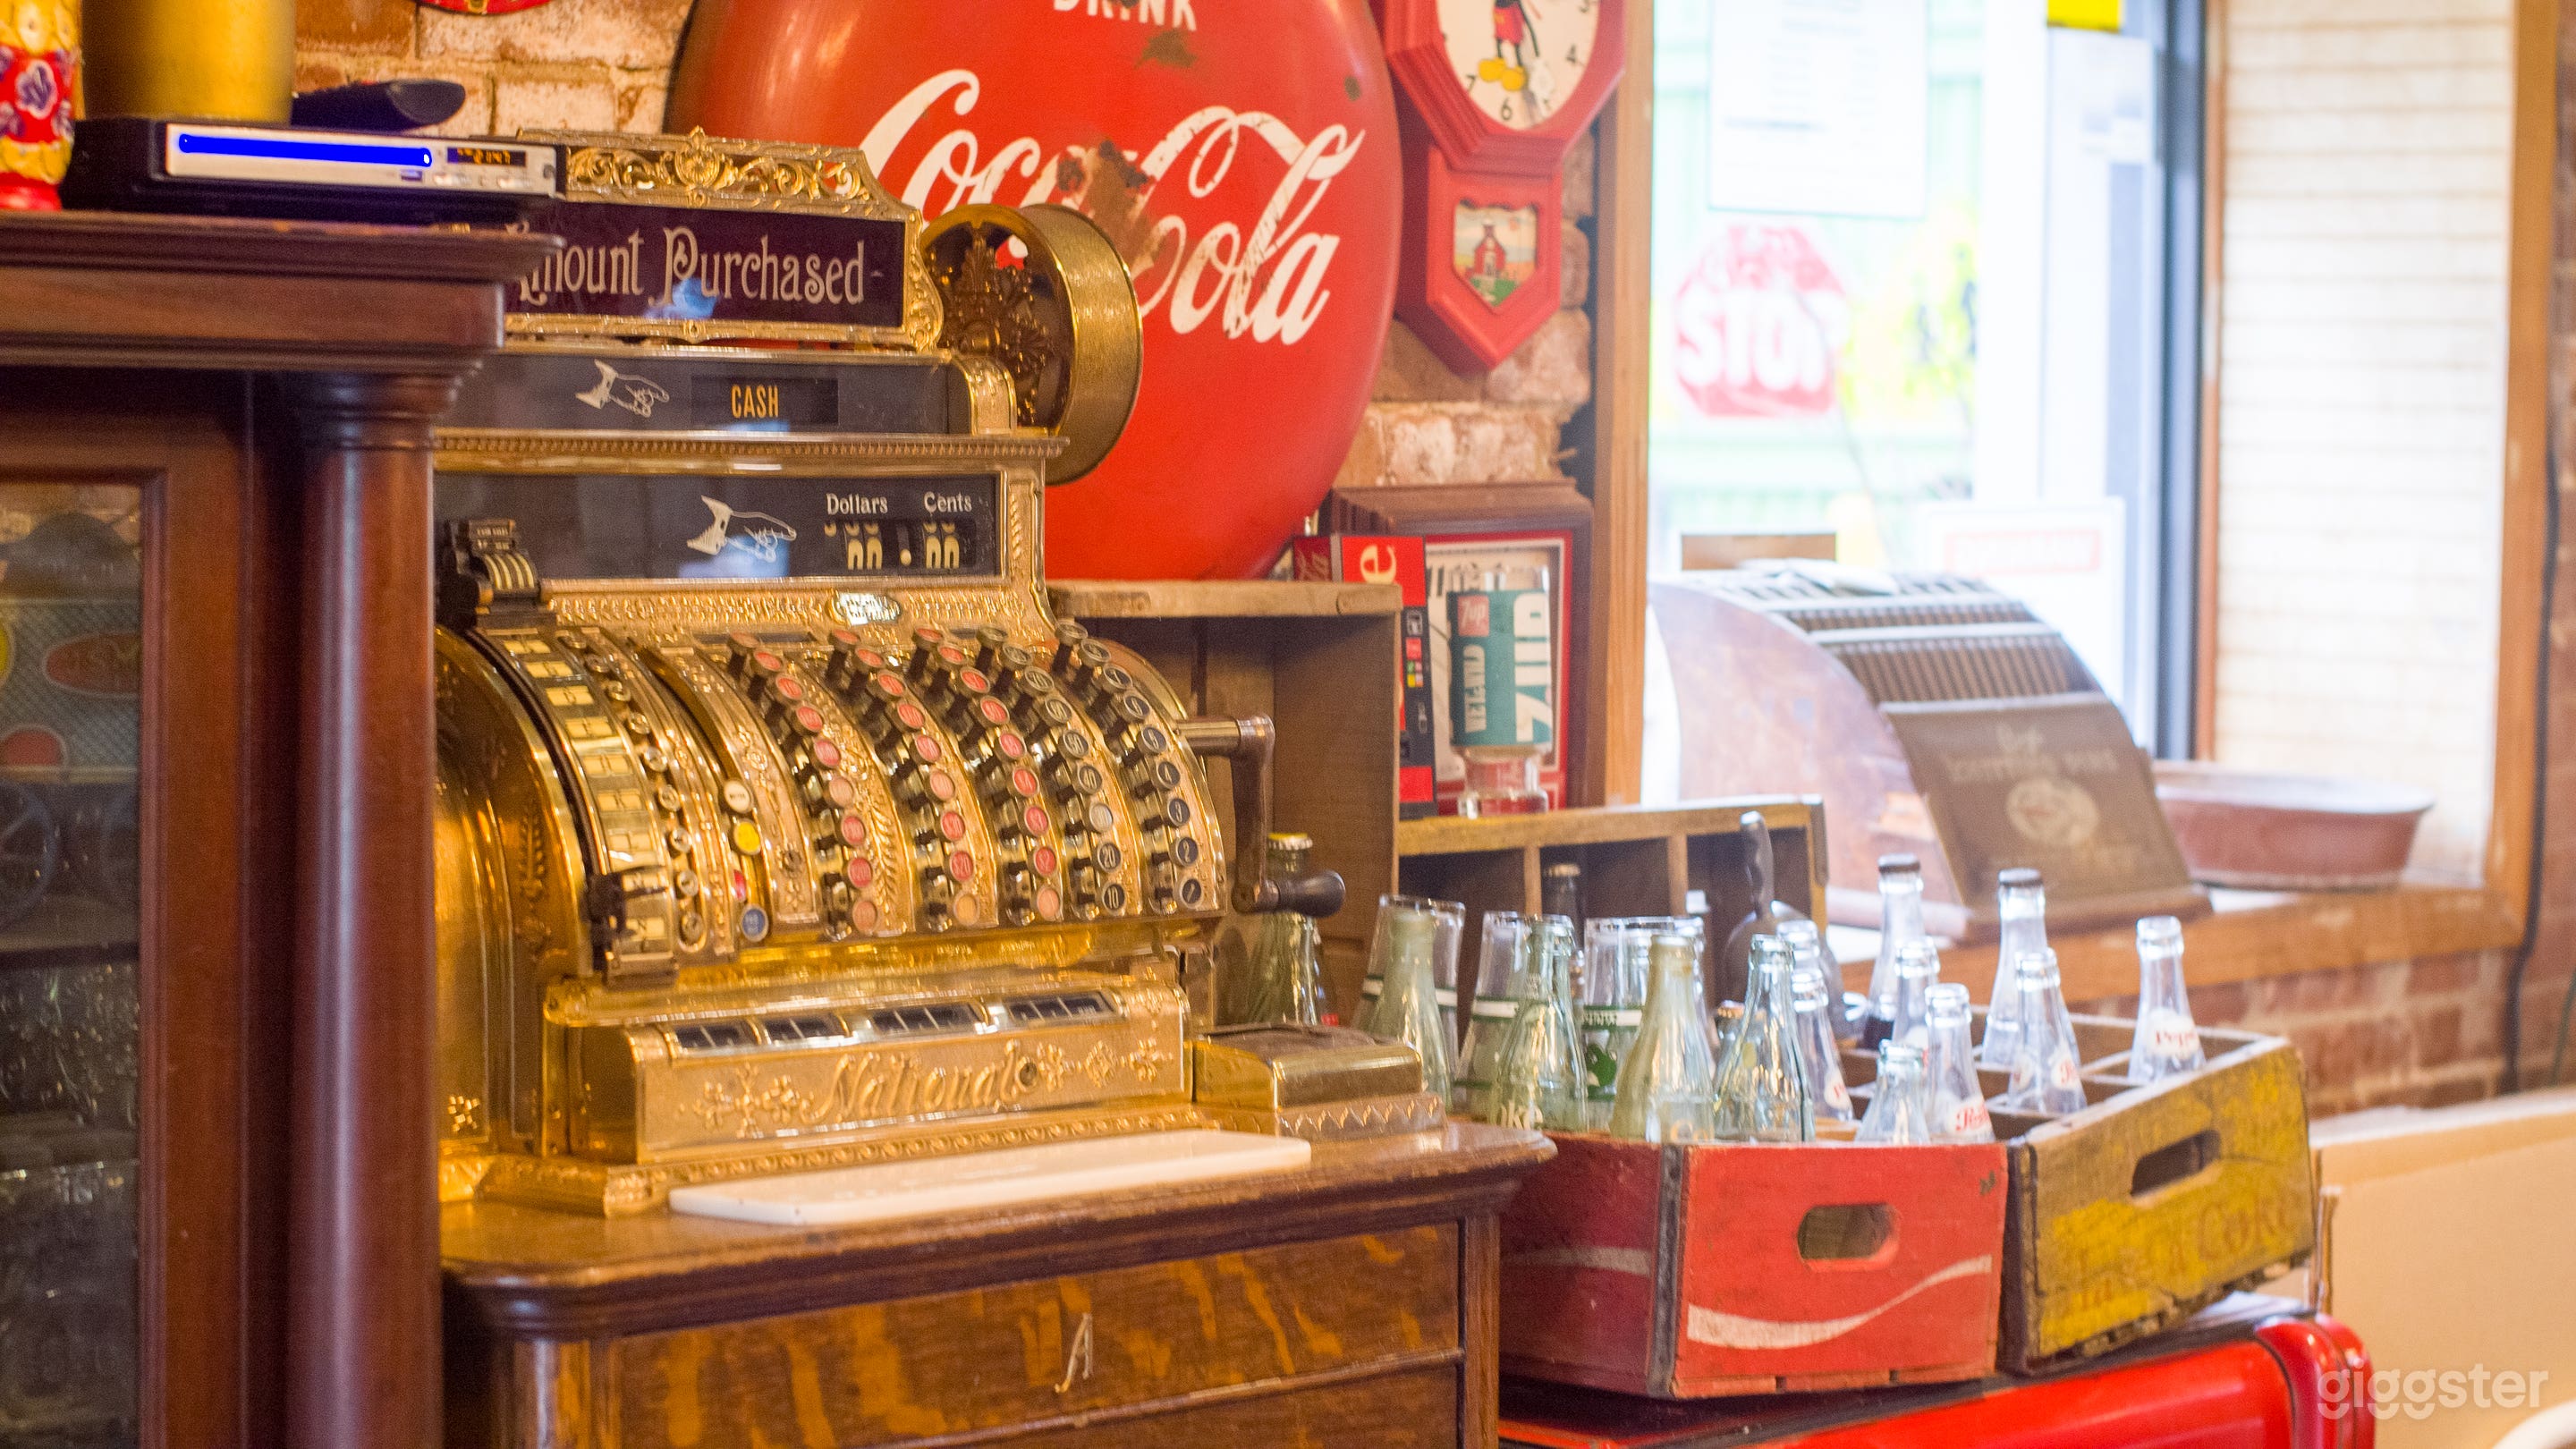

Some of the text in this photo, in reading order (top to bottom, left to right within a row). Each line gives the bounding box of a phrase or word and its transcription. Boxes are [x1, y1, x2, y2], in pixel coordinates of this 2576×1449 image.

[1500, 97, 1513, 122] 6
[648, 225, 865, 309] Purchased
[731, 385, 780, 419] CASH
[826, 491, 973, 516] Dollars Cents
[1102, 844, 1116, 869] 20
[1107, 885, 1119, 909] 10
[801, 1038, 1019, 1124] National
